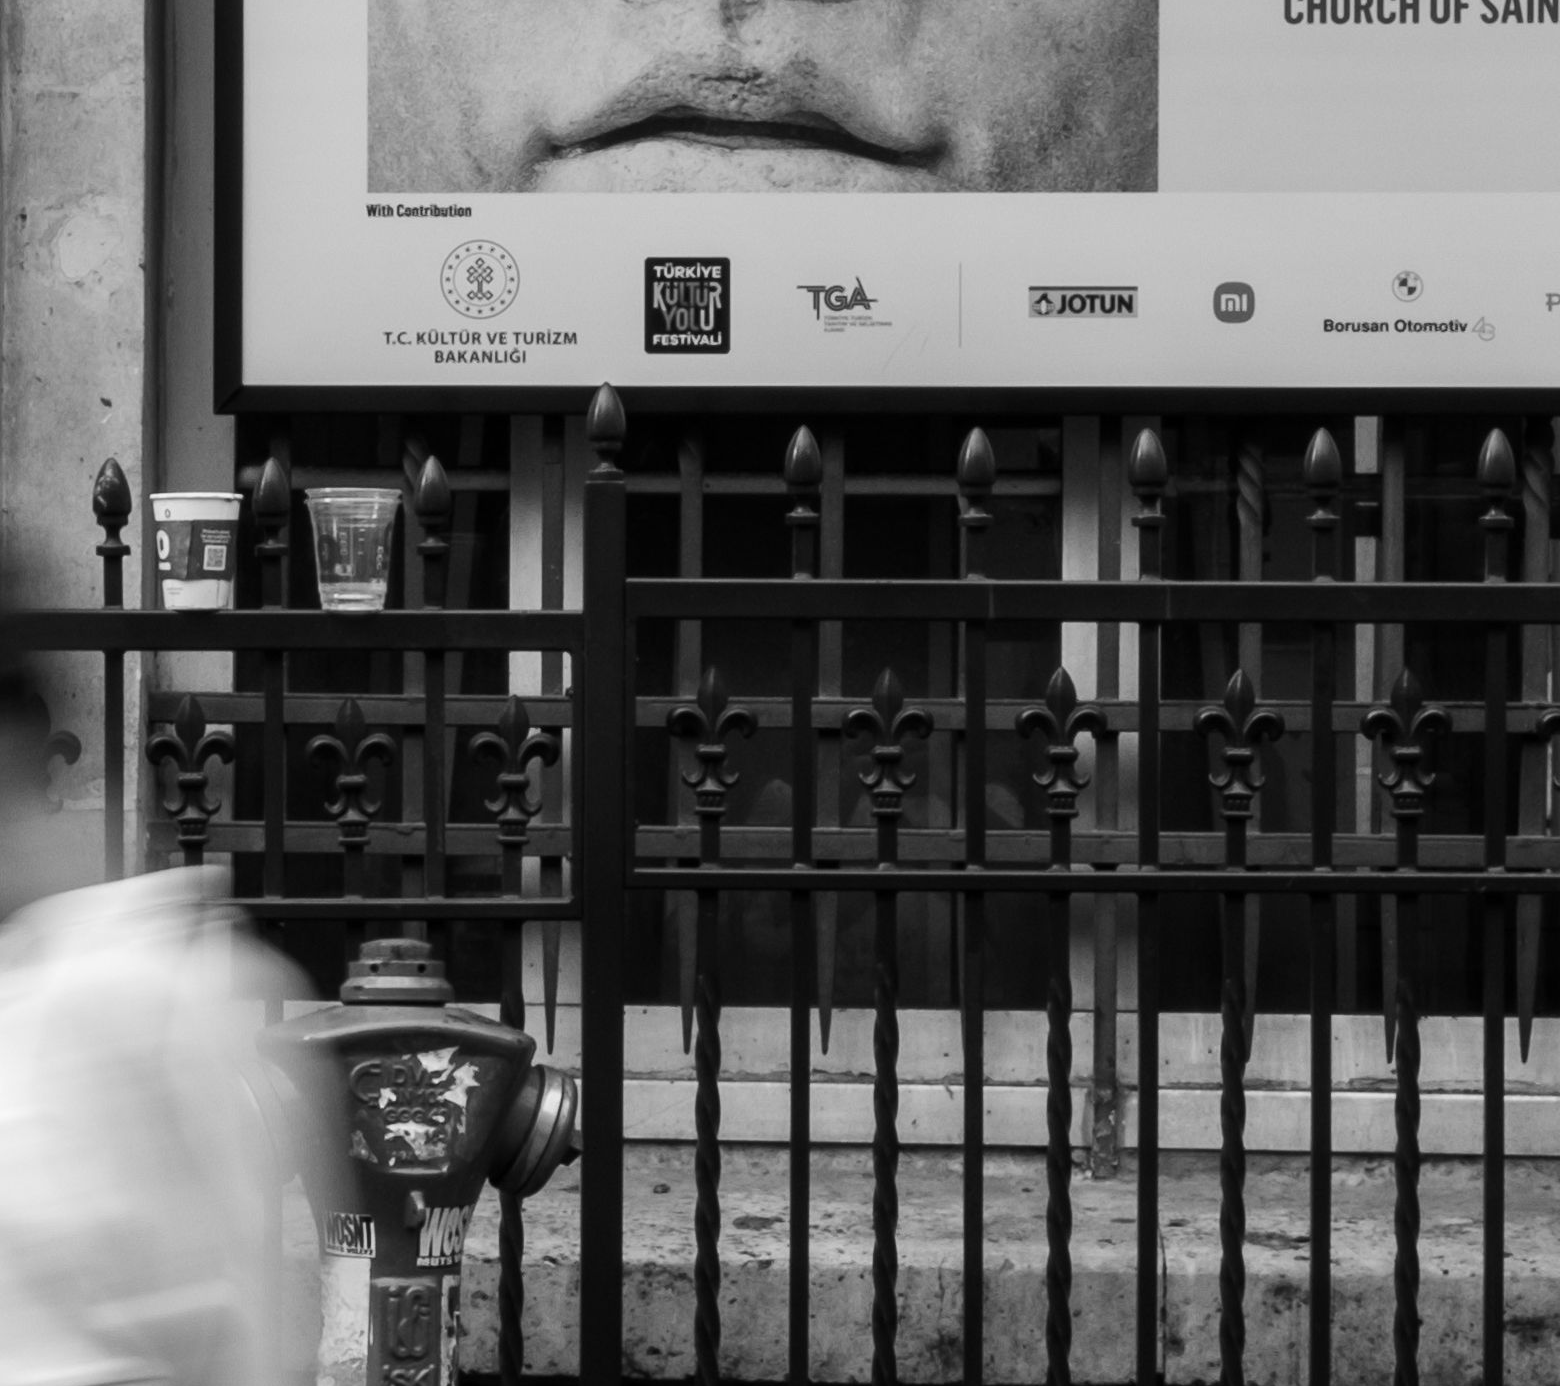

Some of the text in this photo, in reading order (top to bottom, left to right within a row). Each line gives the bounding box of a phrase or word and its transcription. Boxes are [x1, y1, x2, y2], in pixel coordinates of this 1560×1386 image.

[366, 204, 471, 217] With Contribution
[653, 263, 721, 279] TÜRKİYE
[797, 276, 878, 320] TGA
[1057, 294, 1133, 314] JOTUN
[1324, 319, 1389, 332] Borusan
[1394, 319, 1468, 332] Otomotiv
[384, 328, 577, 345] T.C. KÜLTÜR VE TURİZM
[653, 332, 721, 346] FESTİVALİ
[434, 346, 526, 364] BAKANLIĞI
